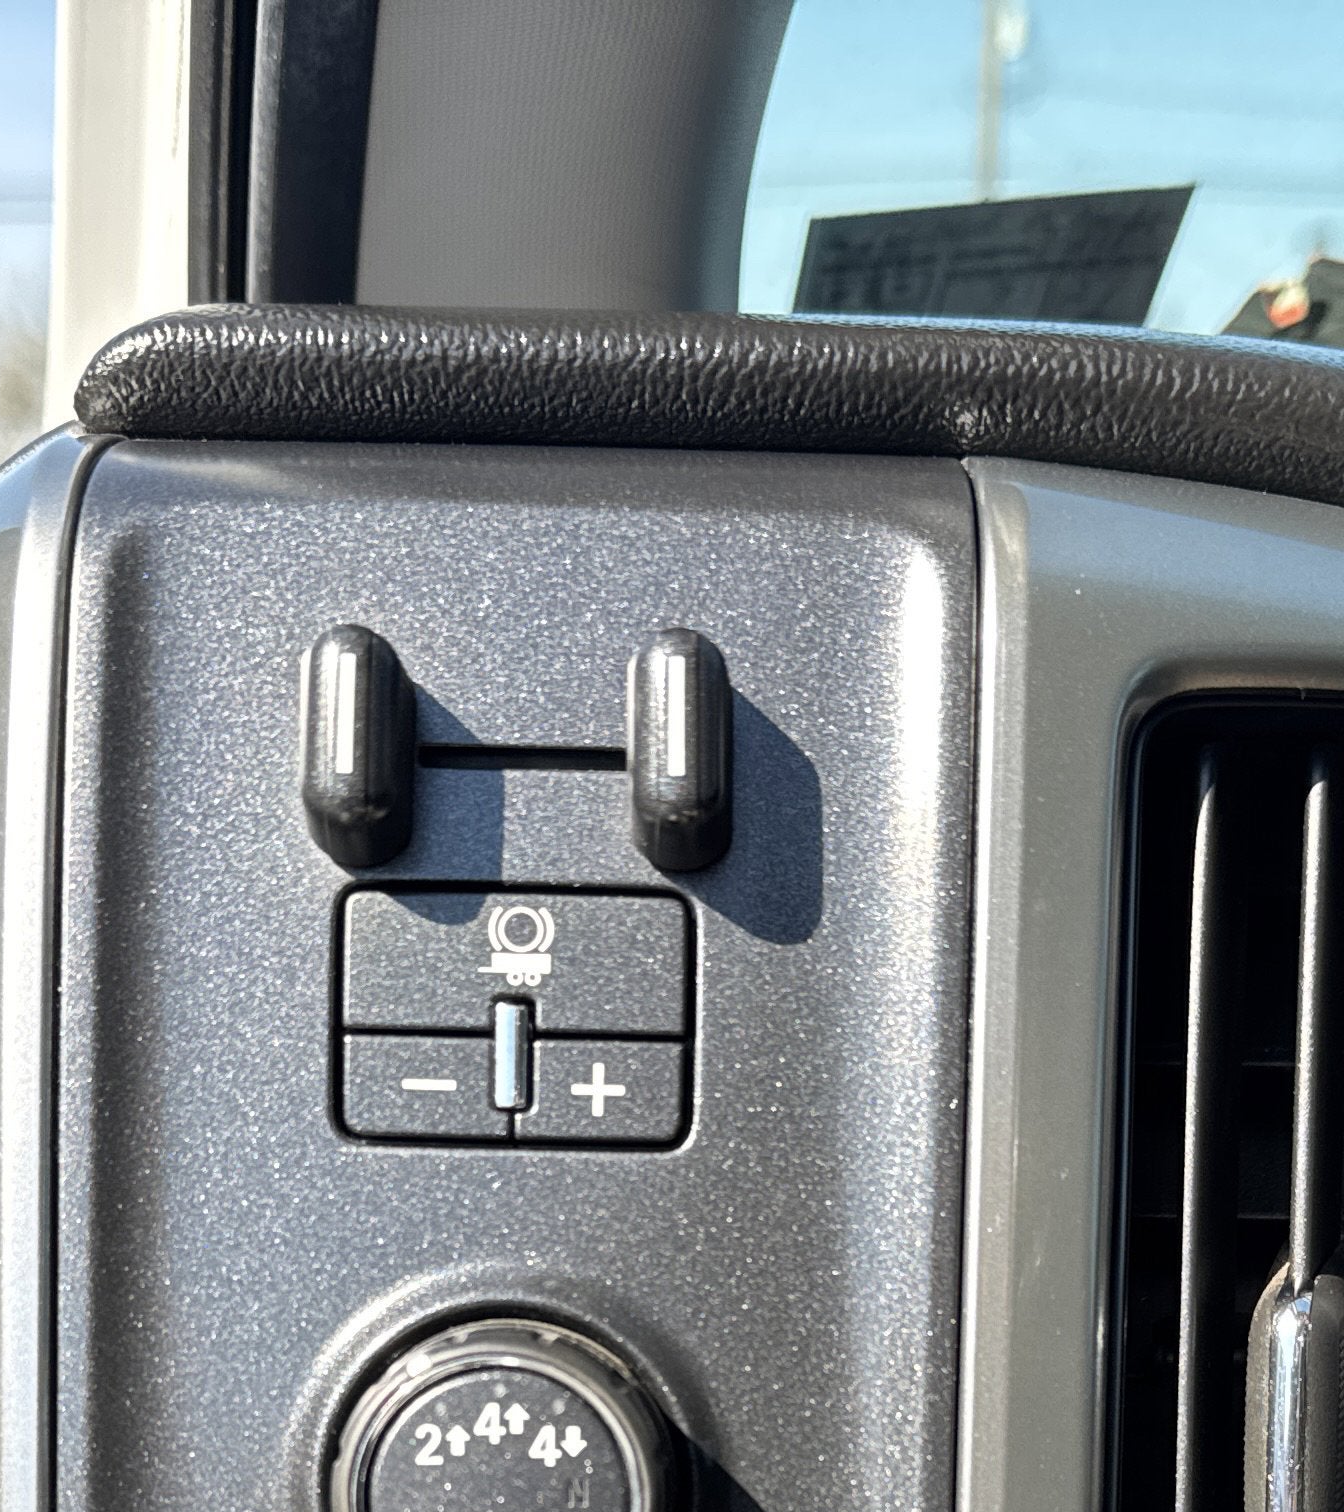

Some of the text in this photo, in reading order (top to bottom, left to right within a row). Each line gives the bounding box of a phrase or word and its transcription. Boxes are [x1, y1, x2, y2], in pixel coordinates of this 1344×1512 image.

[414, 1422, 445, 1466] 2
[474, 1401, 506, 1445] 4
[528, 1424, 563, 1468] 4
